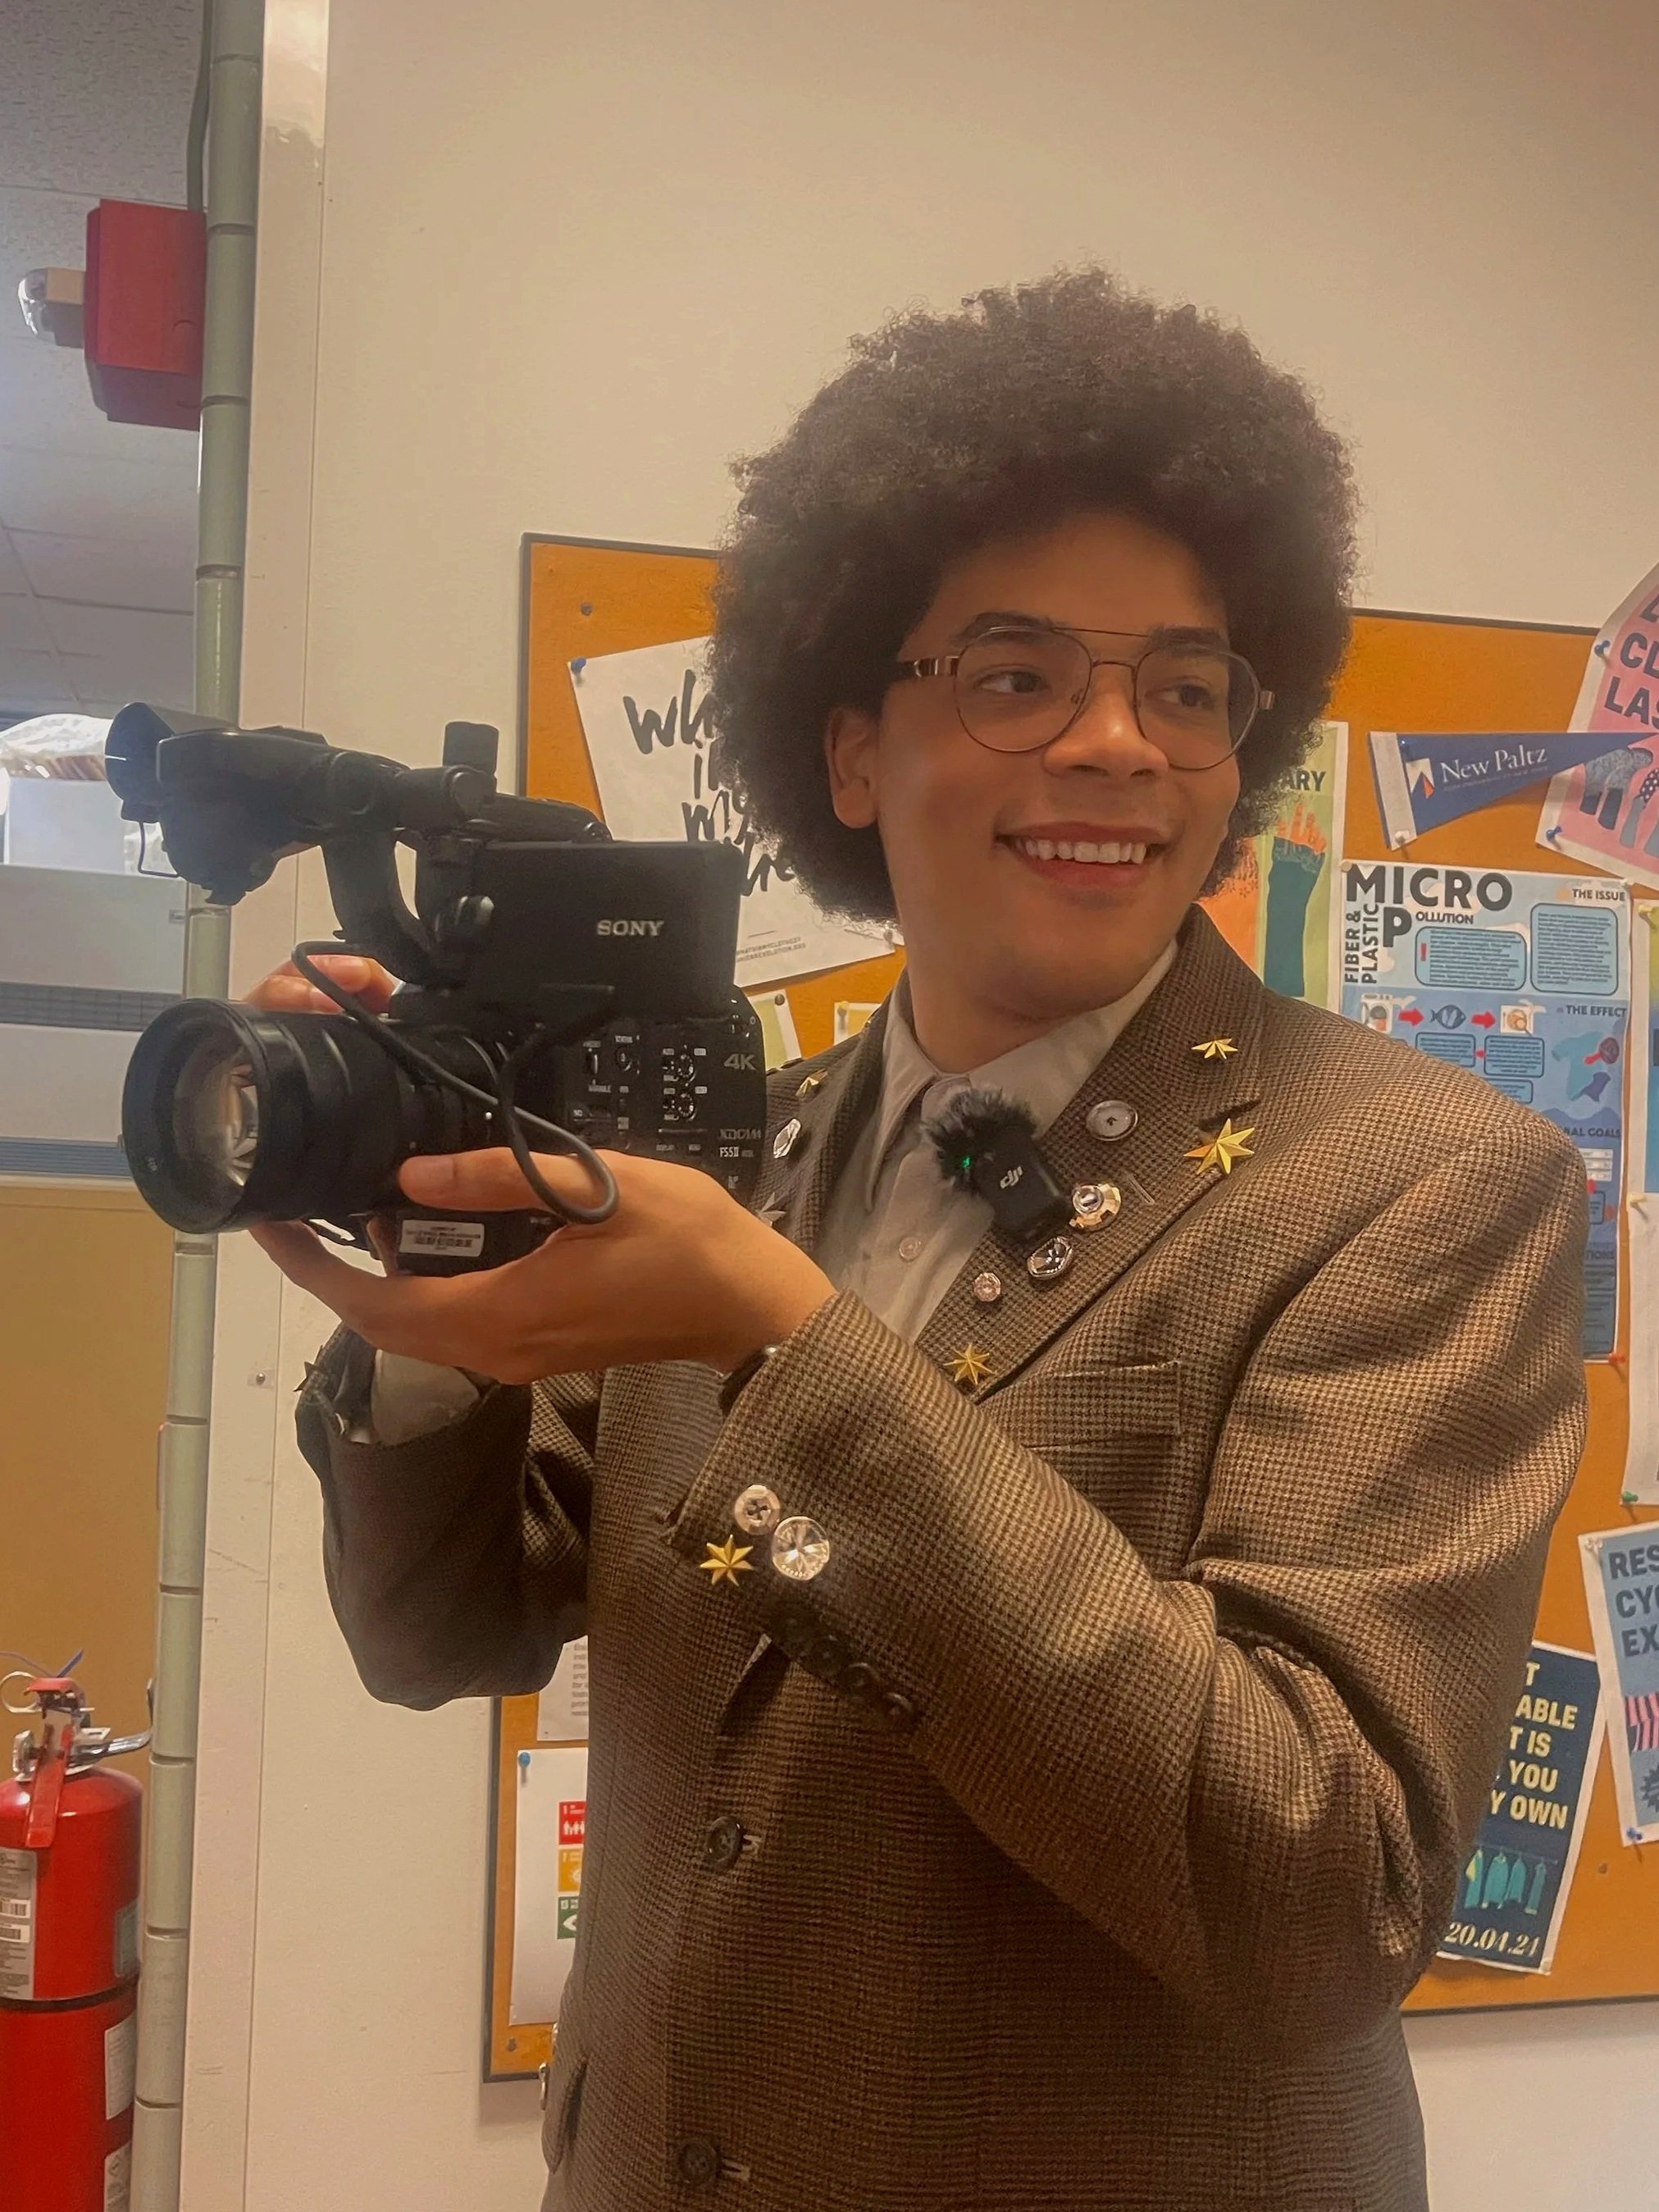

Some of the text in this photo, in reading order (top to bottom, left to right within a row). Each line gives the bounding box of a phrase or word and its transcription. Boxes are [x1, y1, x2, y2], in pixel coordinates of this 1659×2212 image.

[1280, 768, 1327, 792] ARY
[1440, 759, 1490, 783] New
[1494, 744, 1547, 771] Paltz
[1347, 863, 1512, 911] MICRO
[1572, 888, 1625, 901] THE ISSUE
[597, 919, 665, 936] SONY
[1361, 903, 1379, 984] PLASTIC
[1345, 910, 1361, 983] FIBER &
[1566, 1004, 1627, 1018] THE EFFECT
[722, 1053, 757, 1070] 4K
[1616, 1584, 1659, 1618] CY
[1525, 1661, 1541, 1686] T
[1515, 1694, 1578, 1730] ABLE
[1509, 1726, 1552, 1758] T IS
[1509, 1759, 1558, 1793] YOU
[1490, 1789, 1569, 1830] Y OWN
